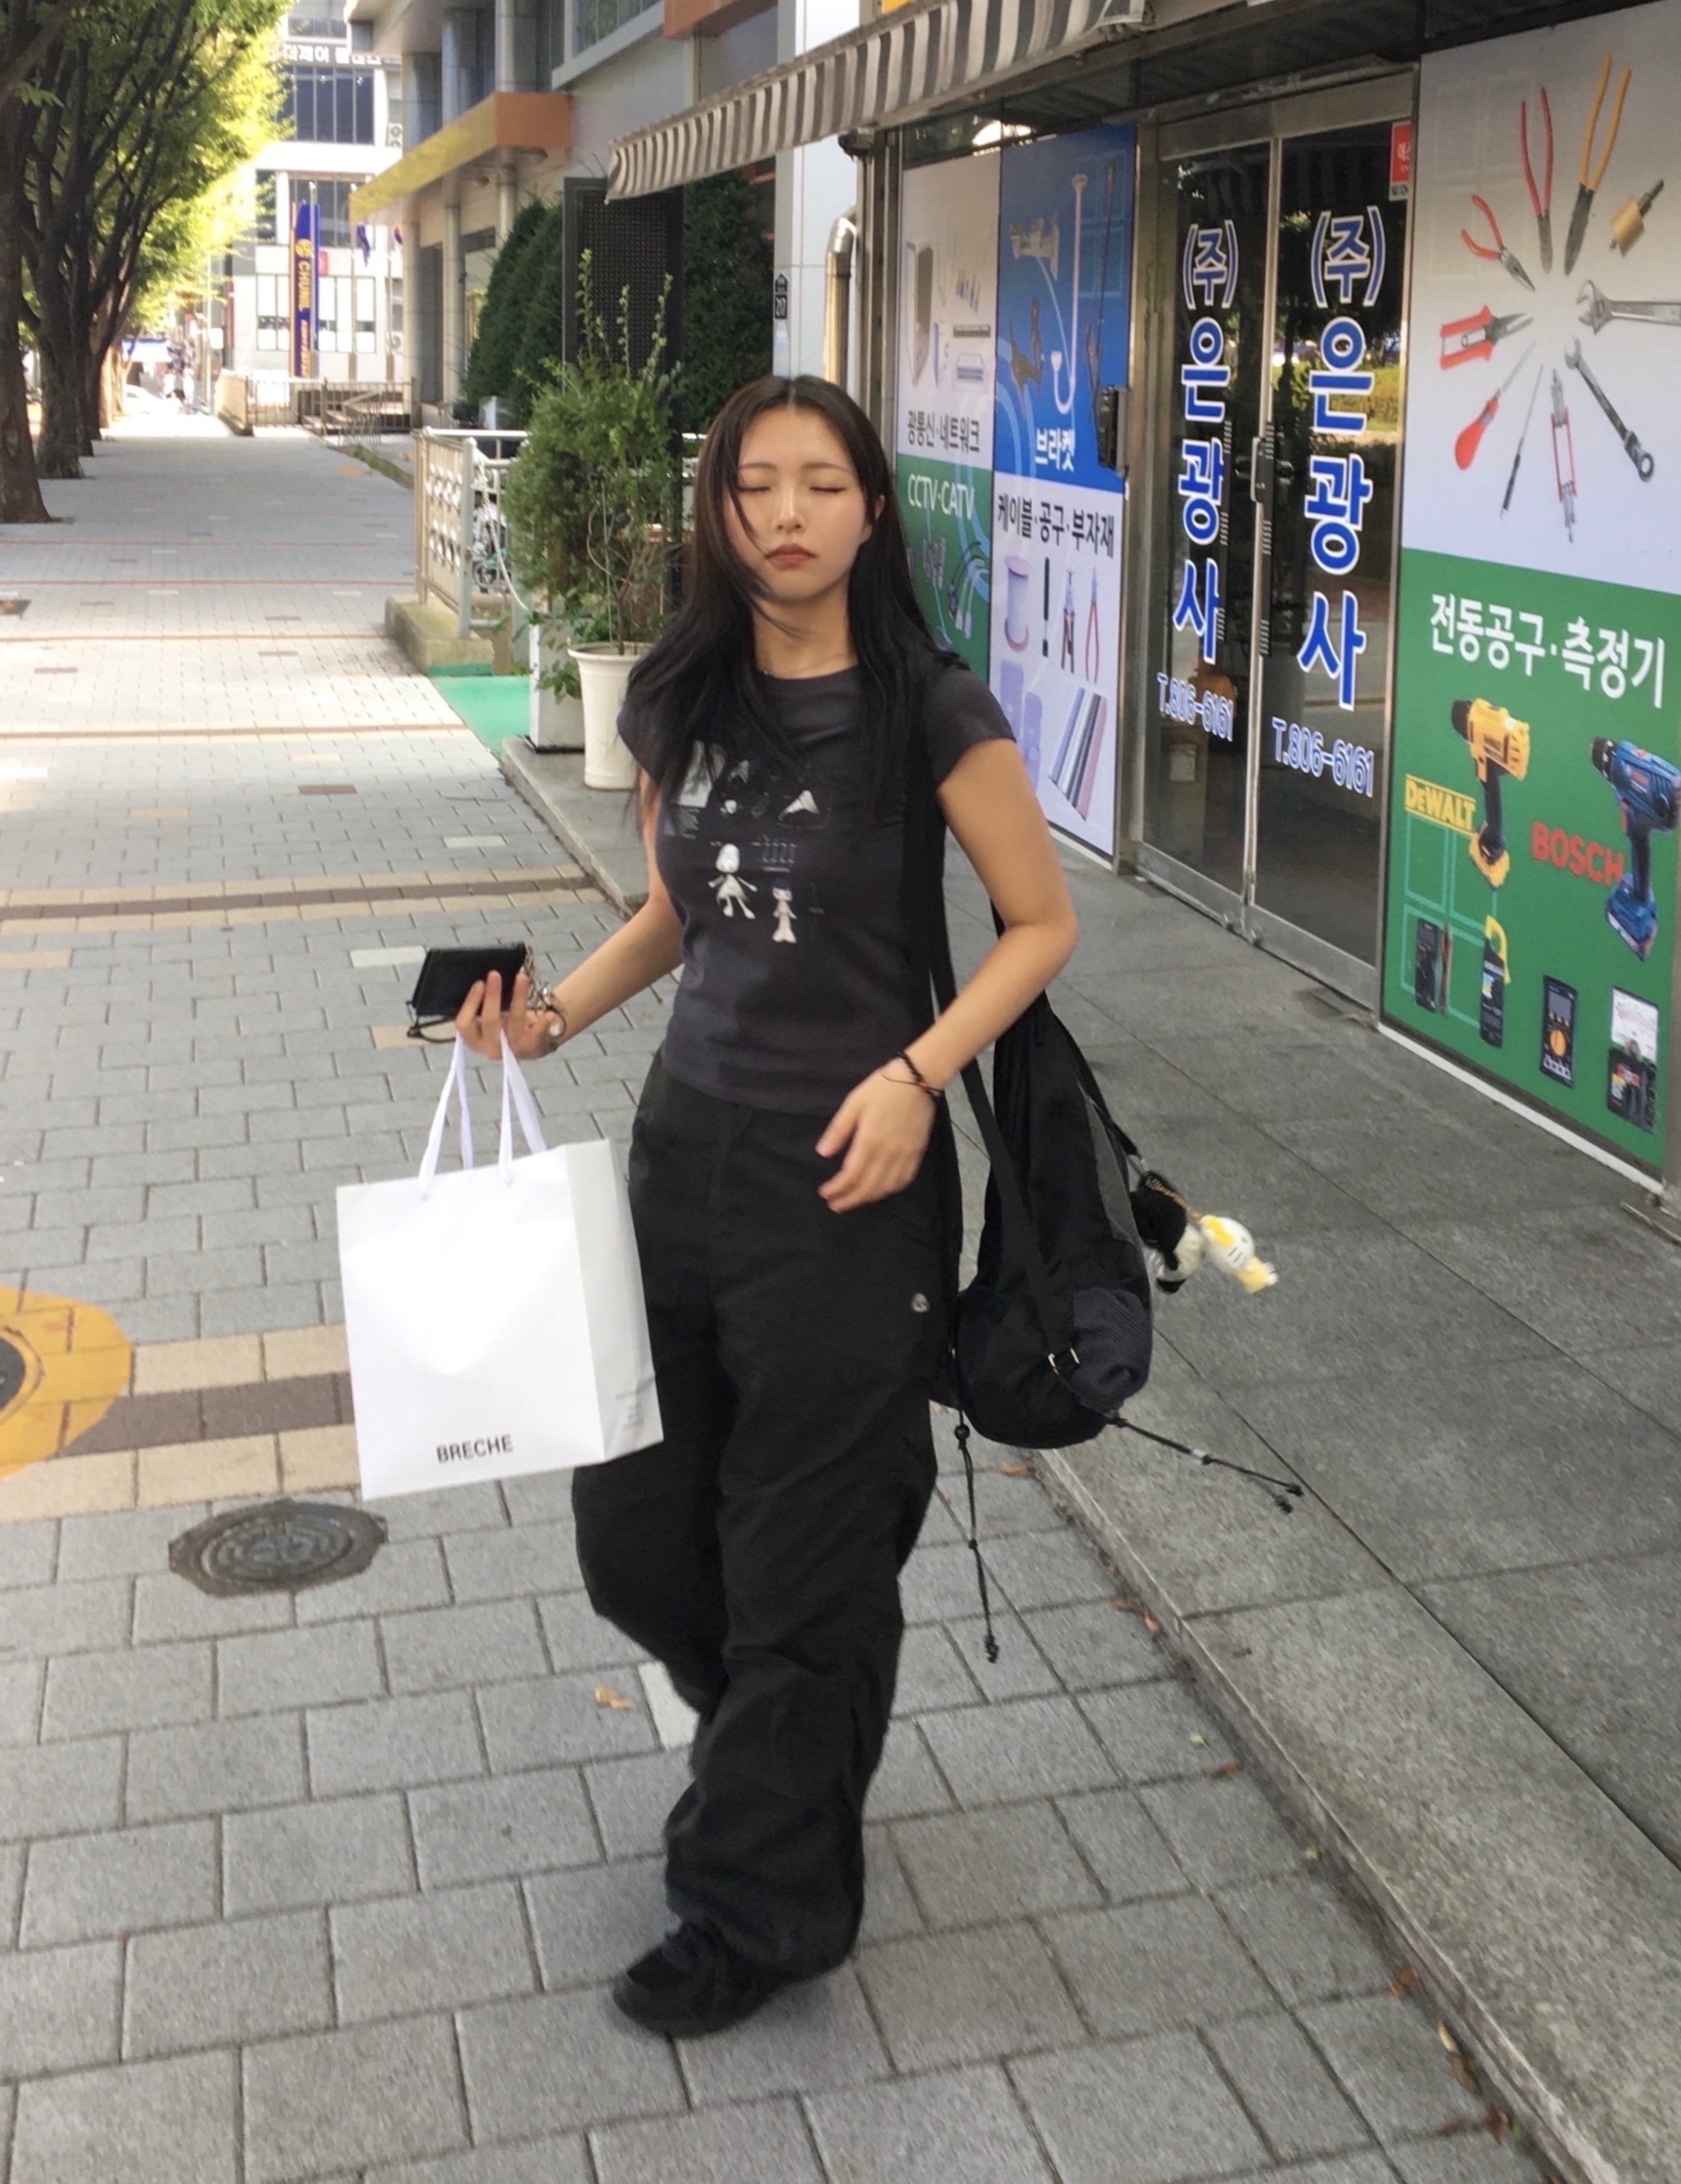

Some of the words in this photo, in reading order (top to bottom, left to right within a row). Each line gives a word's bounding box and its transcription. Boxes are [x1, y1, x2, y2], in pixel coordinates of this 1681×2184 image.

[1035, 428, 1075, 471] 브라켓
[1157, 673, 1234, 741] T.806-6161
[1272, 717, 1374, 796] T.806-6161
[1531, 822, 1624, 884] BOSCH
[437, 1434, 513, 1463] BRECHE
